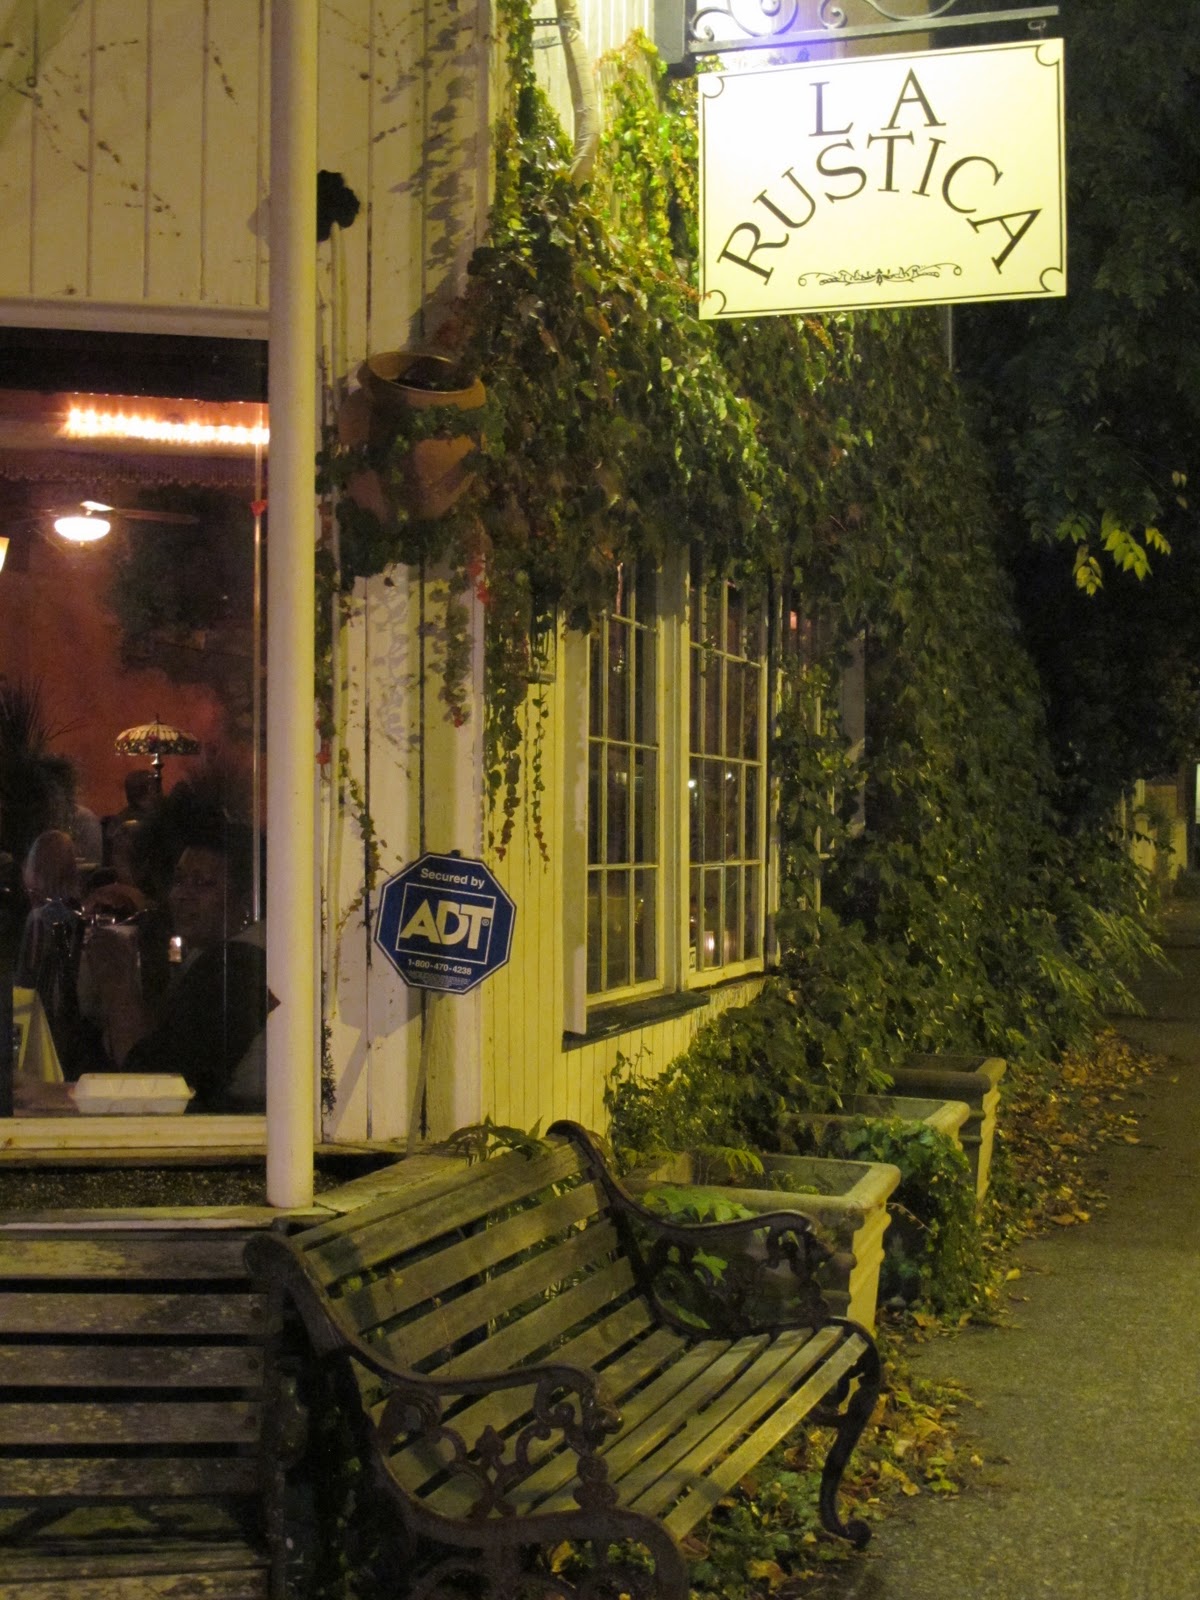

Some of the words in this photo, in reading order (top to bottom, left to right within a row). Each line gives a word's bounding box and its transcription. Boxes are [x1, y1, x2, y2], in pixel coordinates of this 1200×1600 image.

[716, 130, 1043, 286] RUSTICA
[420, 867, 468, 885] Secured
[470, 875, 485, 889] by
[399, 898, 493, 950] ADT
